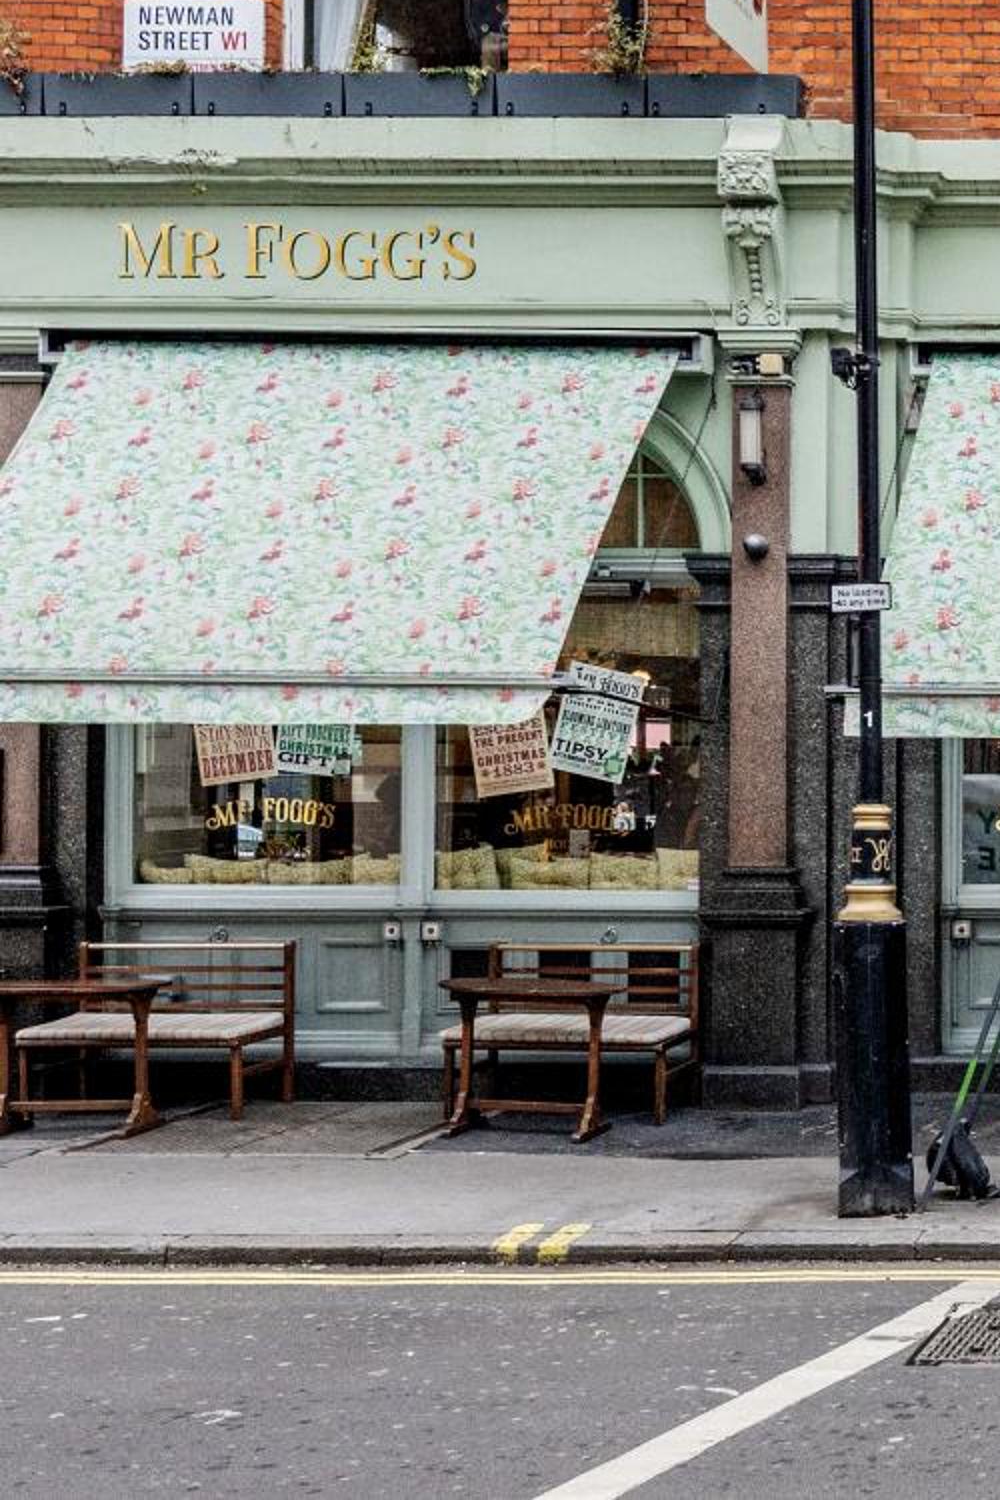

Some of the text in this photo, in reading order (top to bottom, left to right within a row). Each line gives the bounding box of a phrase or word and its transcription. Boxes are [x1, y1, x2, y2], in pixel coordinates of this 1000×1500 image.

[138, 6, 234, 26] NEWMAN
[138, 30, 248, 51] STREET W1
[117, 220, 477, 281] MR FOGG'S
[863, 710, 873, 728] 1
[474, 735, 494, 748] THE
[497, 729, 544, 745] PRESENT
[278, 751, 332, 768] GIFT
[477, 747, 546, 768] CHRISTMAS
[555, 738, 608, 761] TIPSY
[202, 749, 275, 779] DECEMBER
[262, 797, 336, 829] FOGG'S
[503, 803, 551, 836] MR
